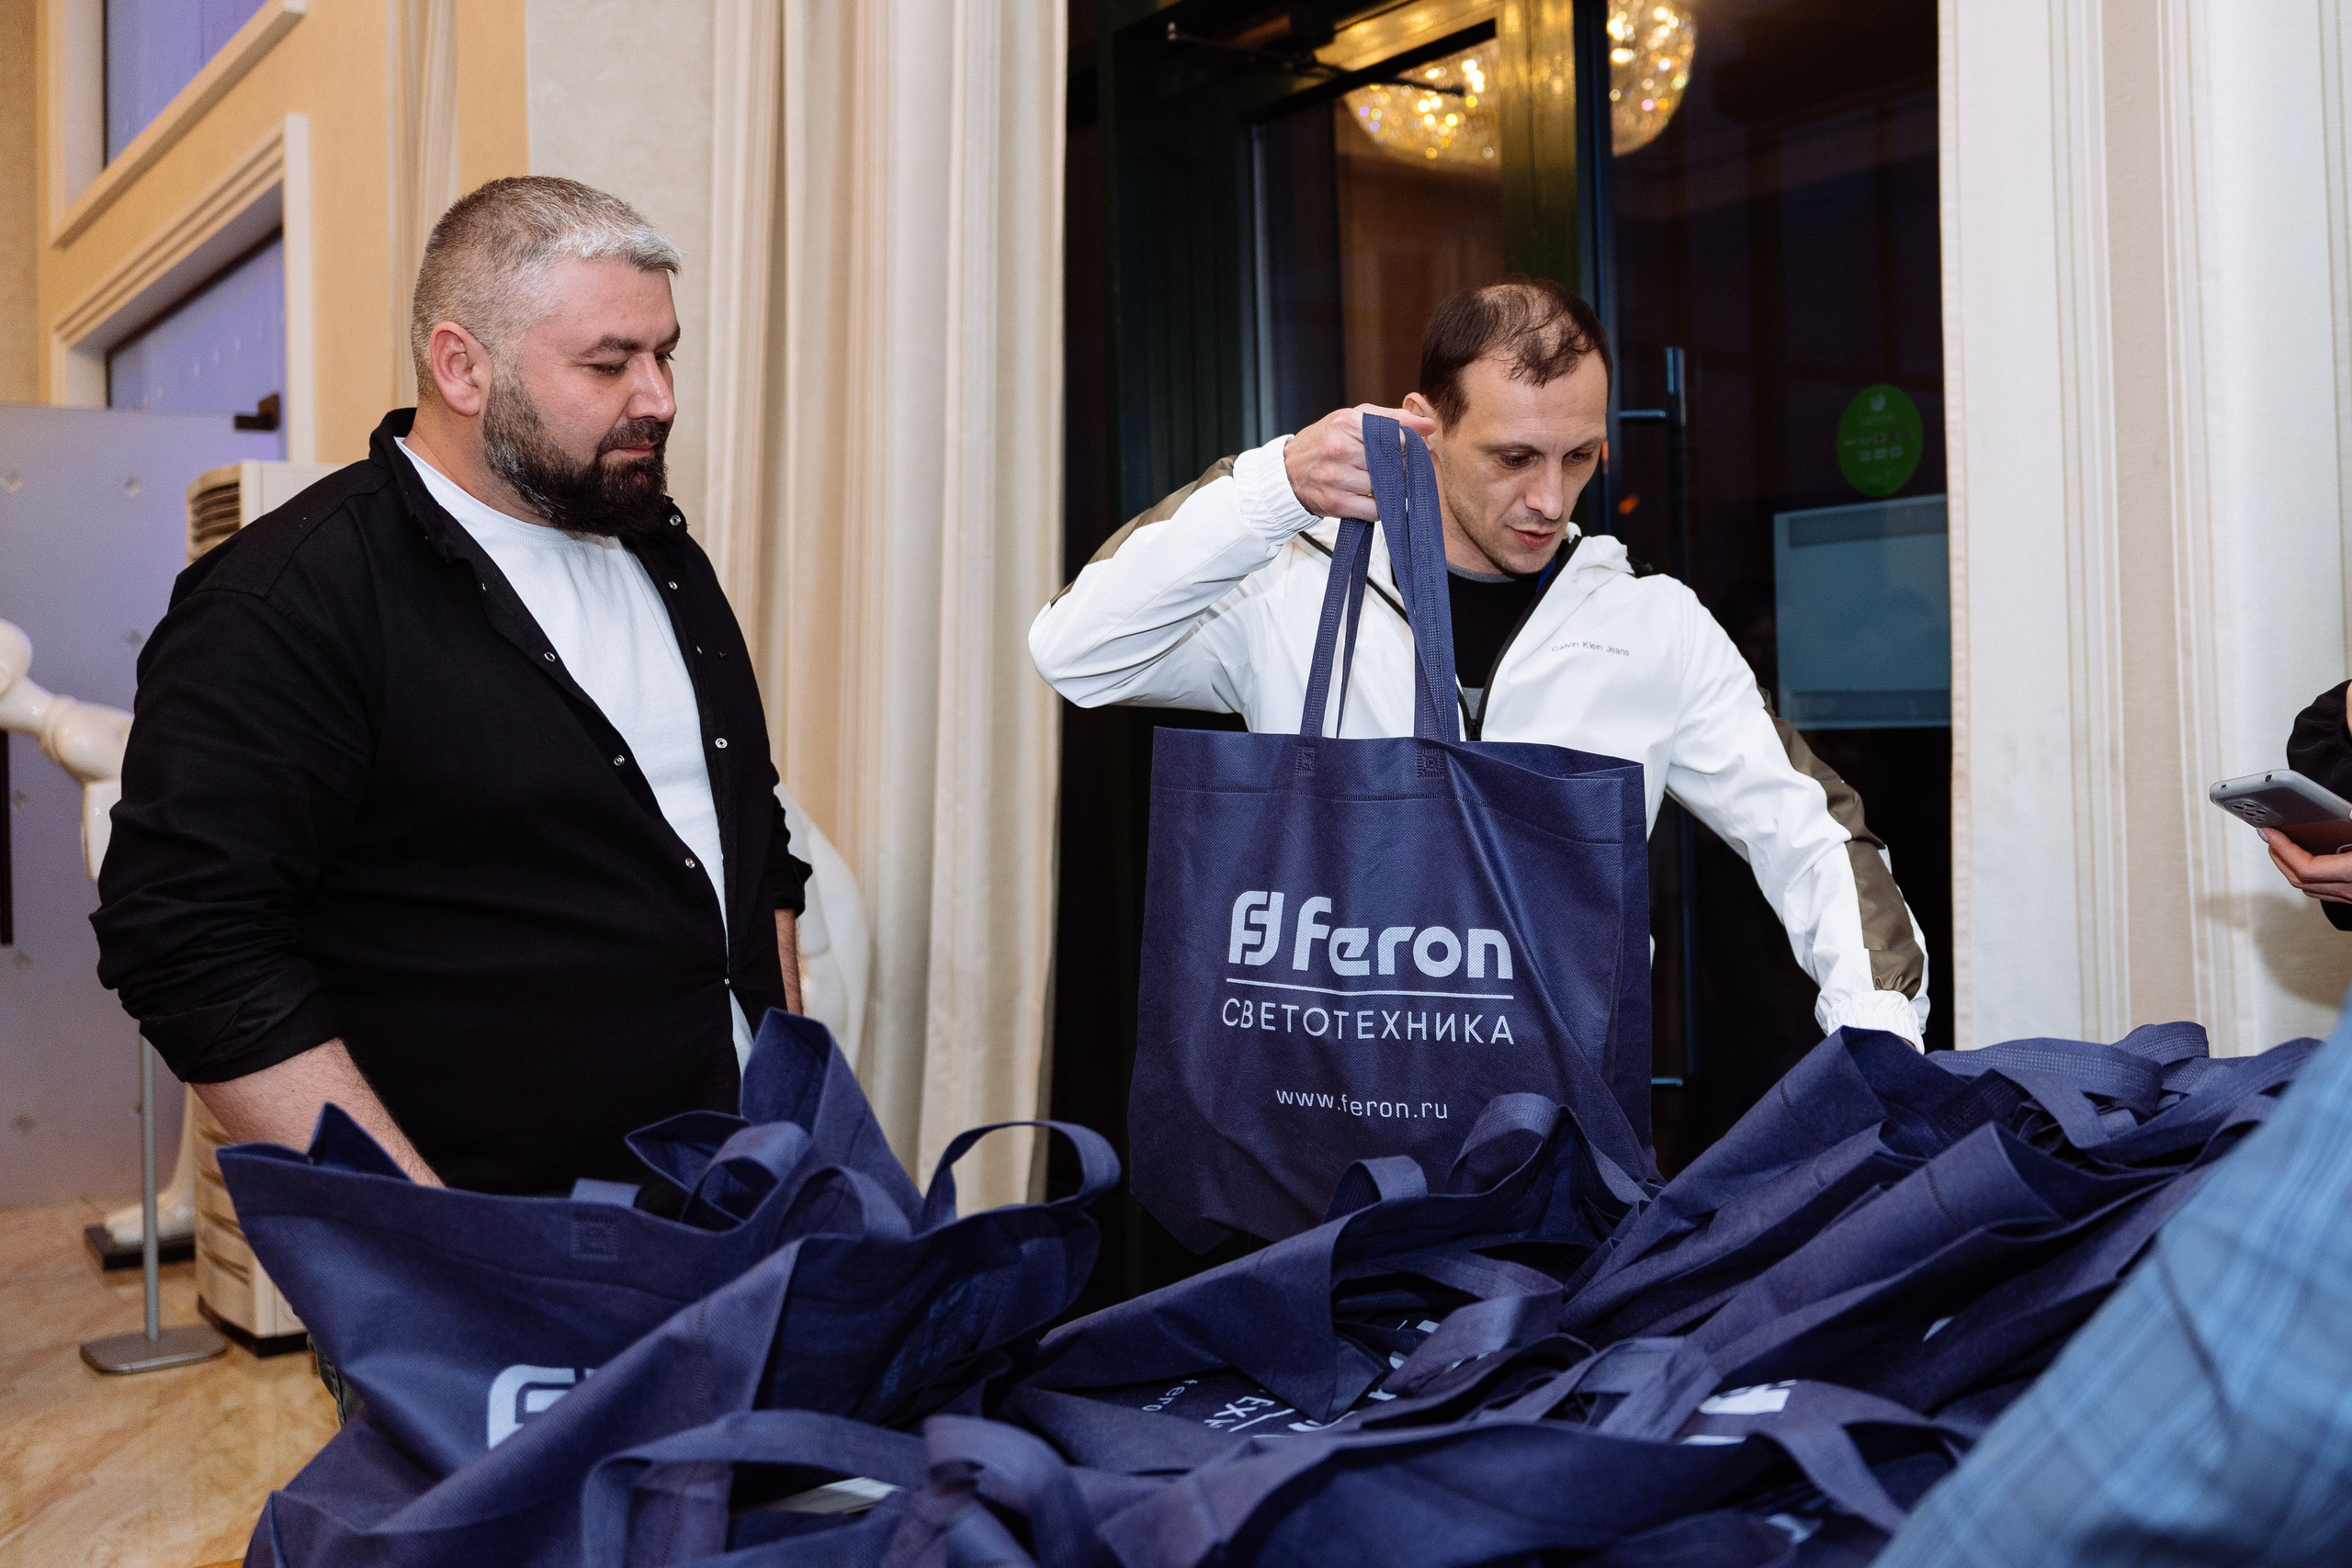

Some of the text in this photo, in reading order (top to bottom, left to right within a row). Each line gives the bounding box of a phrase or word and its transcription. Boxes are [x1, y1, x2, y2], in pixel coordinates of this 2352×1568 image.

[1552, 641, 1630, 657] Calvin Klein Jeans
[1292, 896, 1513, 979] feron
[1221, 998, 1515, 1044] СВЕТОТЕХНИКА
[1276, 1089, 1448, 1119] www.feron.ru
